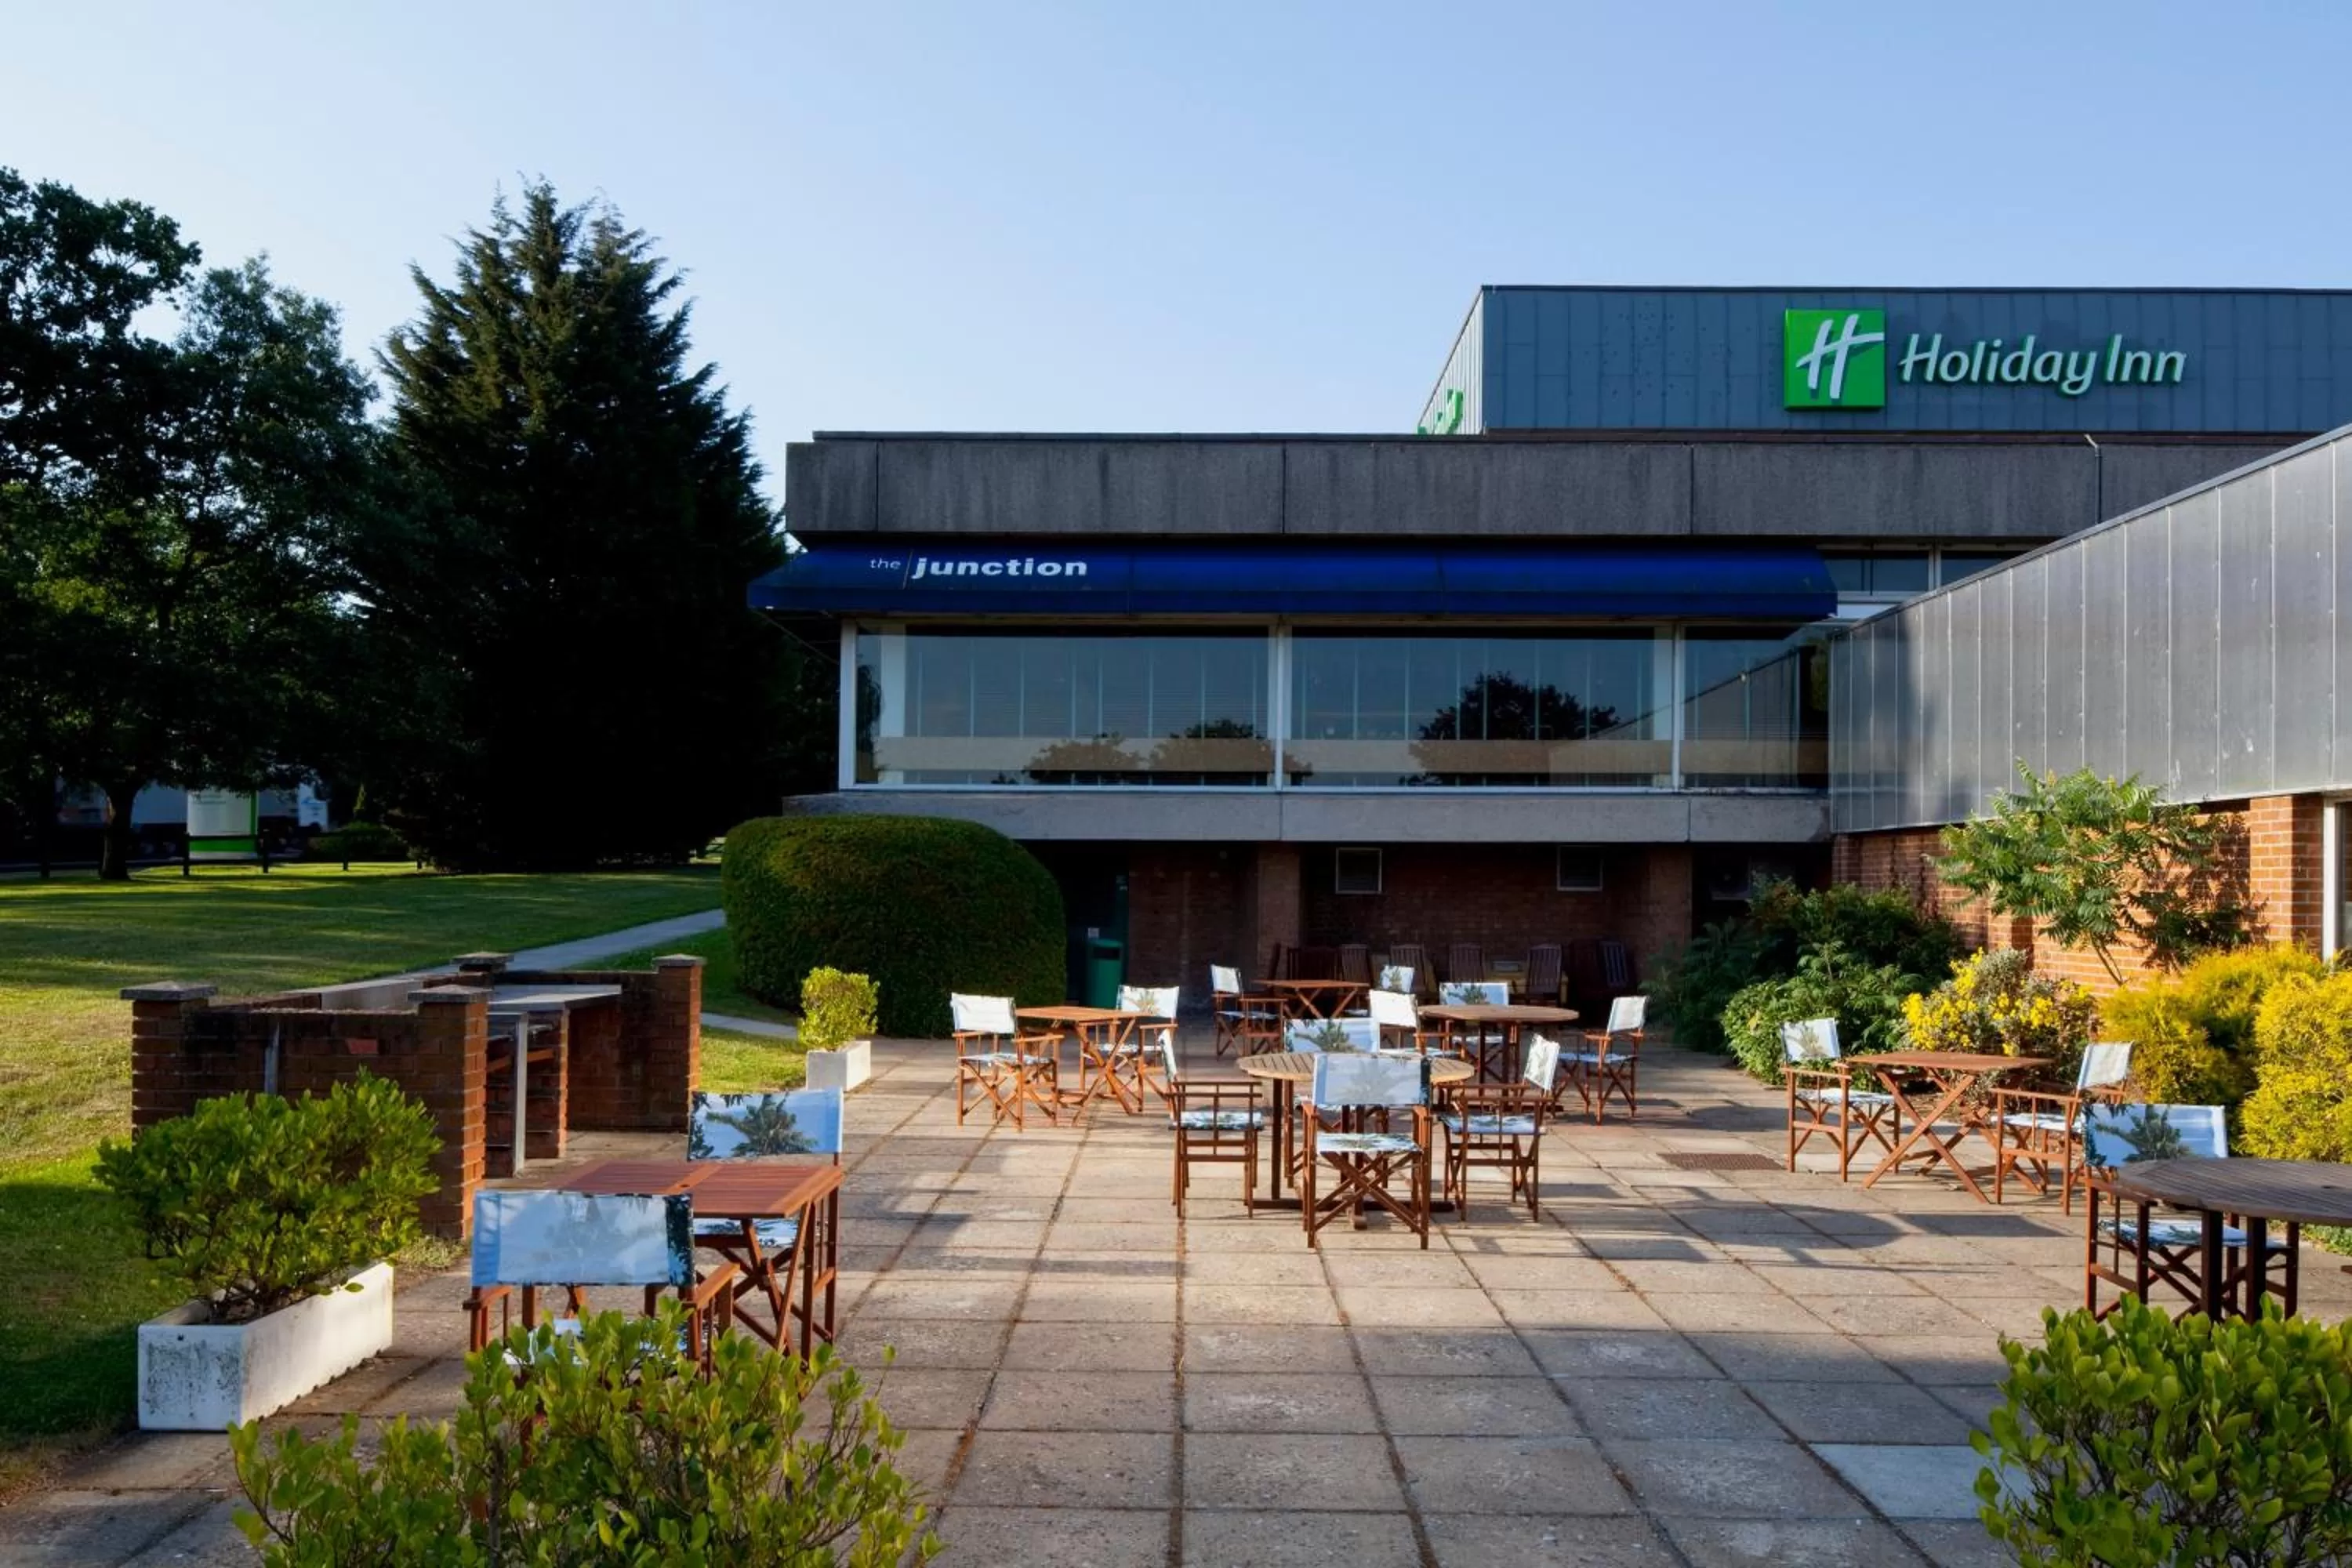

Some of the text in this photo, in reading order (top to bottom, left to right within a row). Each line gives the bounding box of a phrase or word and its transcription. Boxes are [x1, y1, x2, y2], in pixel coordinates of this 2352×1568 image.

[1899, 333, 2186, 395] Holiday Inn
[869, 557, 1088, 579] the junction
